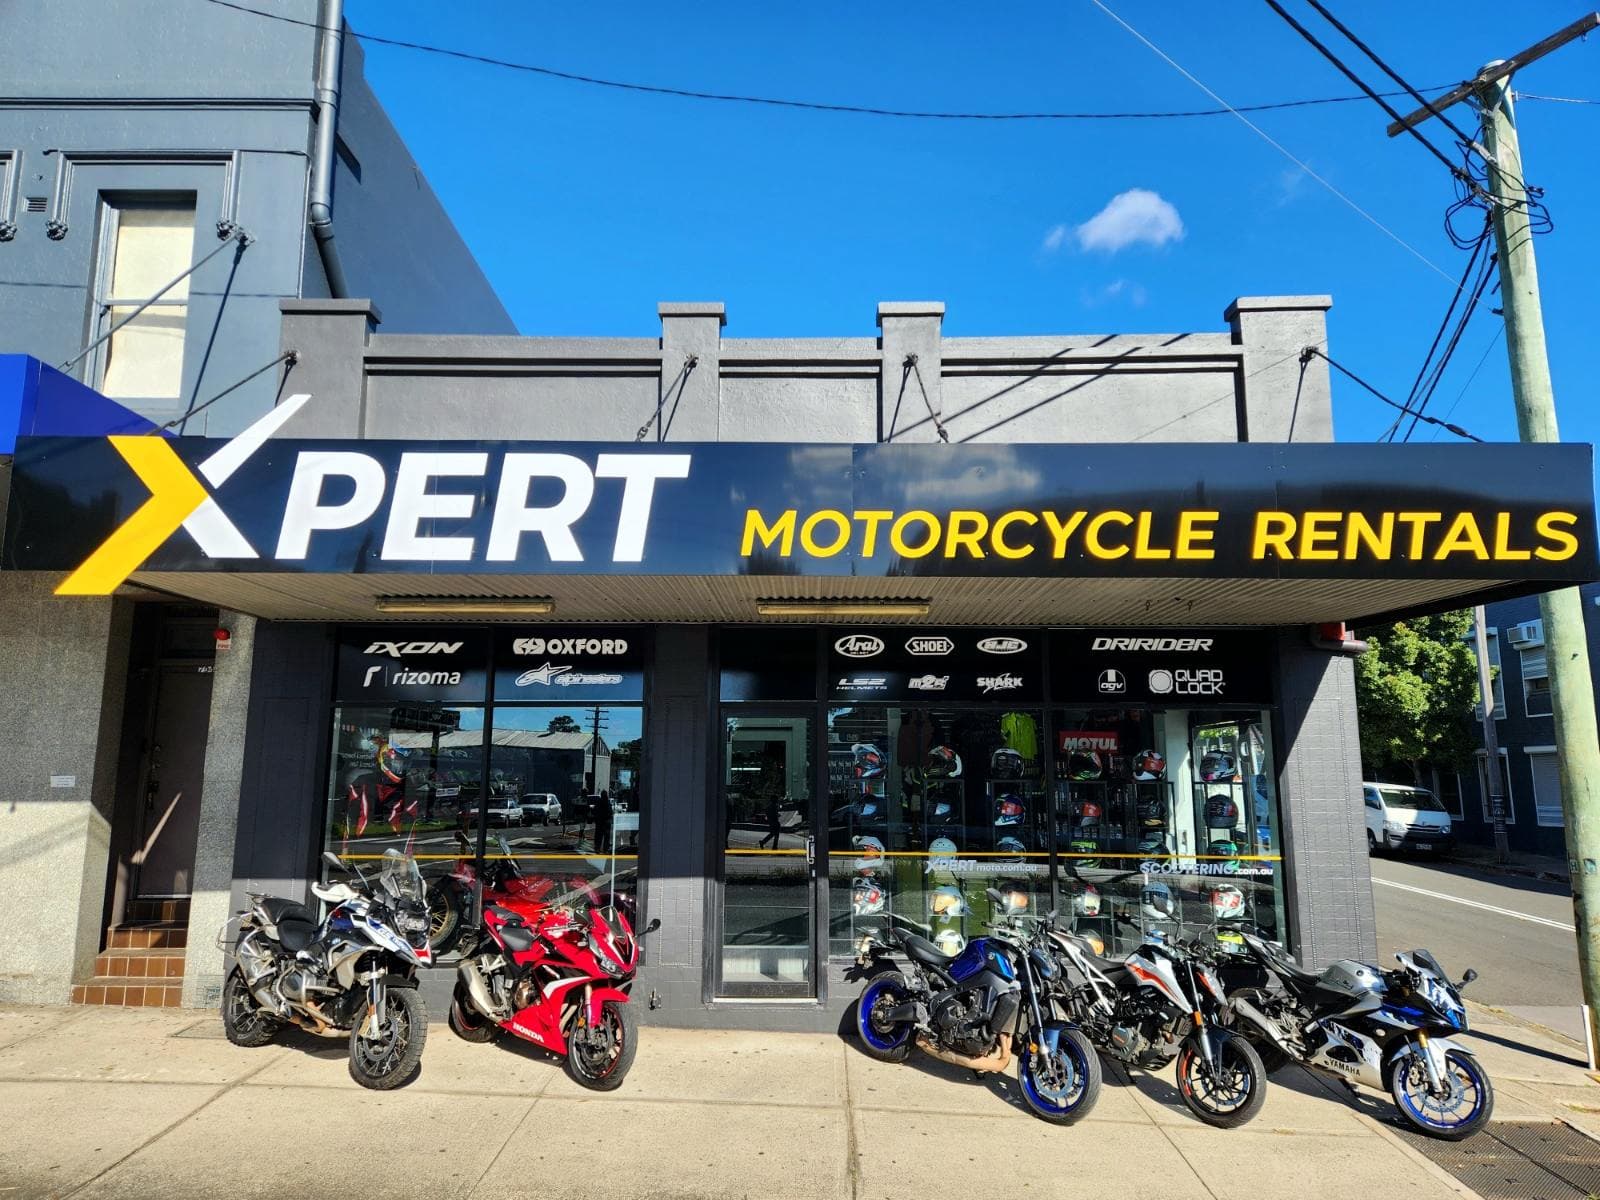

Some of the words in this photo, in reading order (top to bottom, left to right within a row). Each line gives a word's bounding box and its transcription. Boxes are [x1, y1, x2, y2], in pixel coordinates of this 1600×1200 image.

[55, 394, 691, 595] XPERT
[740, 509, 1220, 561] MOTORCYCLE
[1252, 511, 1579, 562] RENTALS
[547, 639, 628, 655] OXFORD
[912, 641, 948, 652] SHOEI
[1091, 638, 1213, 651] DRIRIDER
[392, 667, 461, 685] rizoma
[976, 673, 1023, 694] SHARK
[1175, 669, 1223, 682] QUAD
[1175, 682, 1223, 694] LOCK
[1063, 737, 1118, 751] MOTUL
[513, 1022, 545, 1043] HONDA
[1330, 1059, 1361, 1076] YAMAHA
